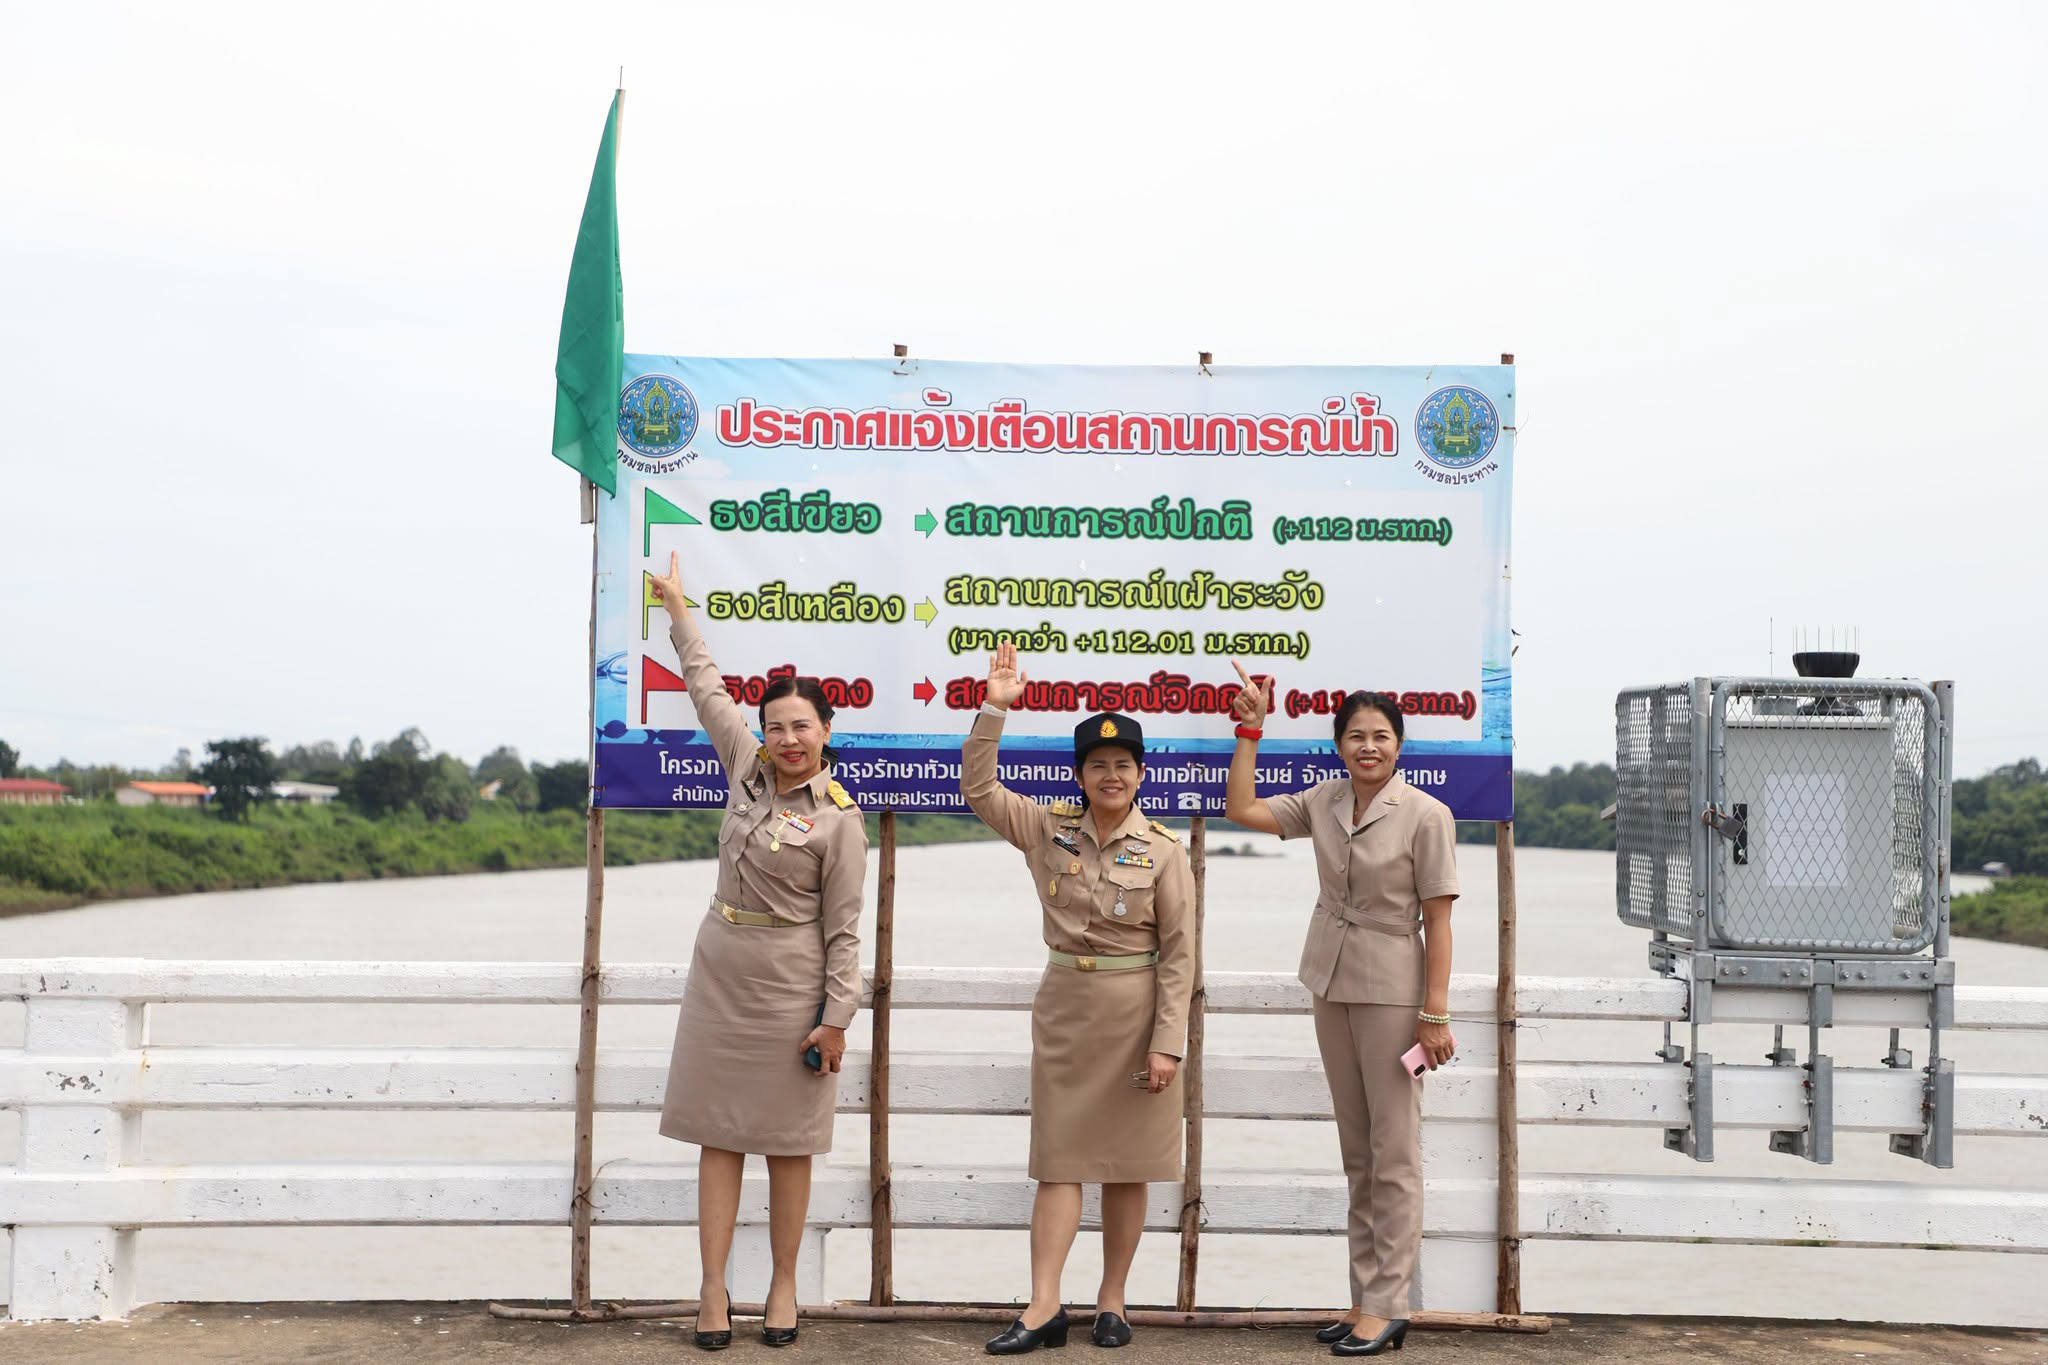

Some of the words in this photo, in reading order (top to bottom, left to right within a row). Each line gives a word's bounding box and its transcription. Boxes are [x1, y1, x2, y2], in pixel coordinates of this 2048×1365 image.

[717, 388, 1398, 457] ประกาศแจ้งเตือนสถานการณ์น้ำ
[1415, 459, 1498, 485] กรมชลประทาน
[710, 488, 882, 534] ธงสีเขียว
[945, 495, 1252, 541] สถานการณ์ปกติ
[707, 579, 906, 624] ธงสีเหลือง
[945, 569, 1324, 611] สถานการณ์เฝ้าระวัง
[1074, 629, 1194, 655] +112.01
